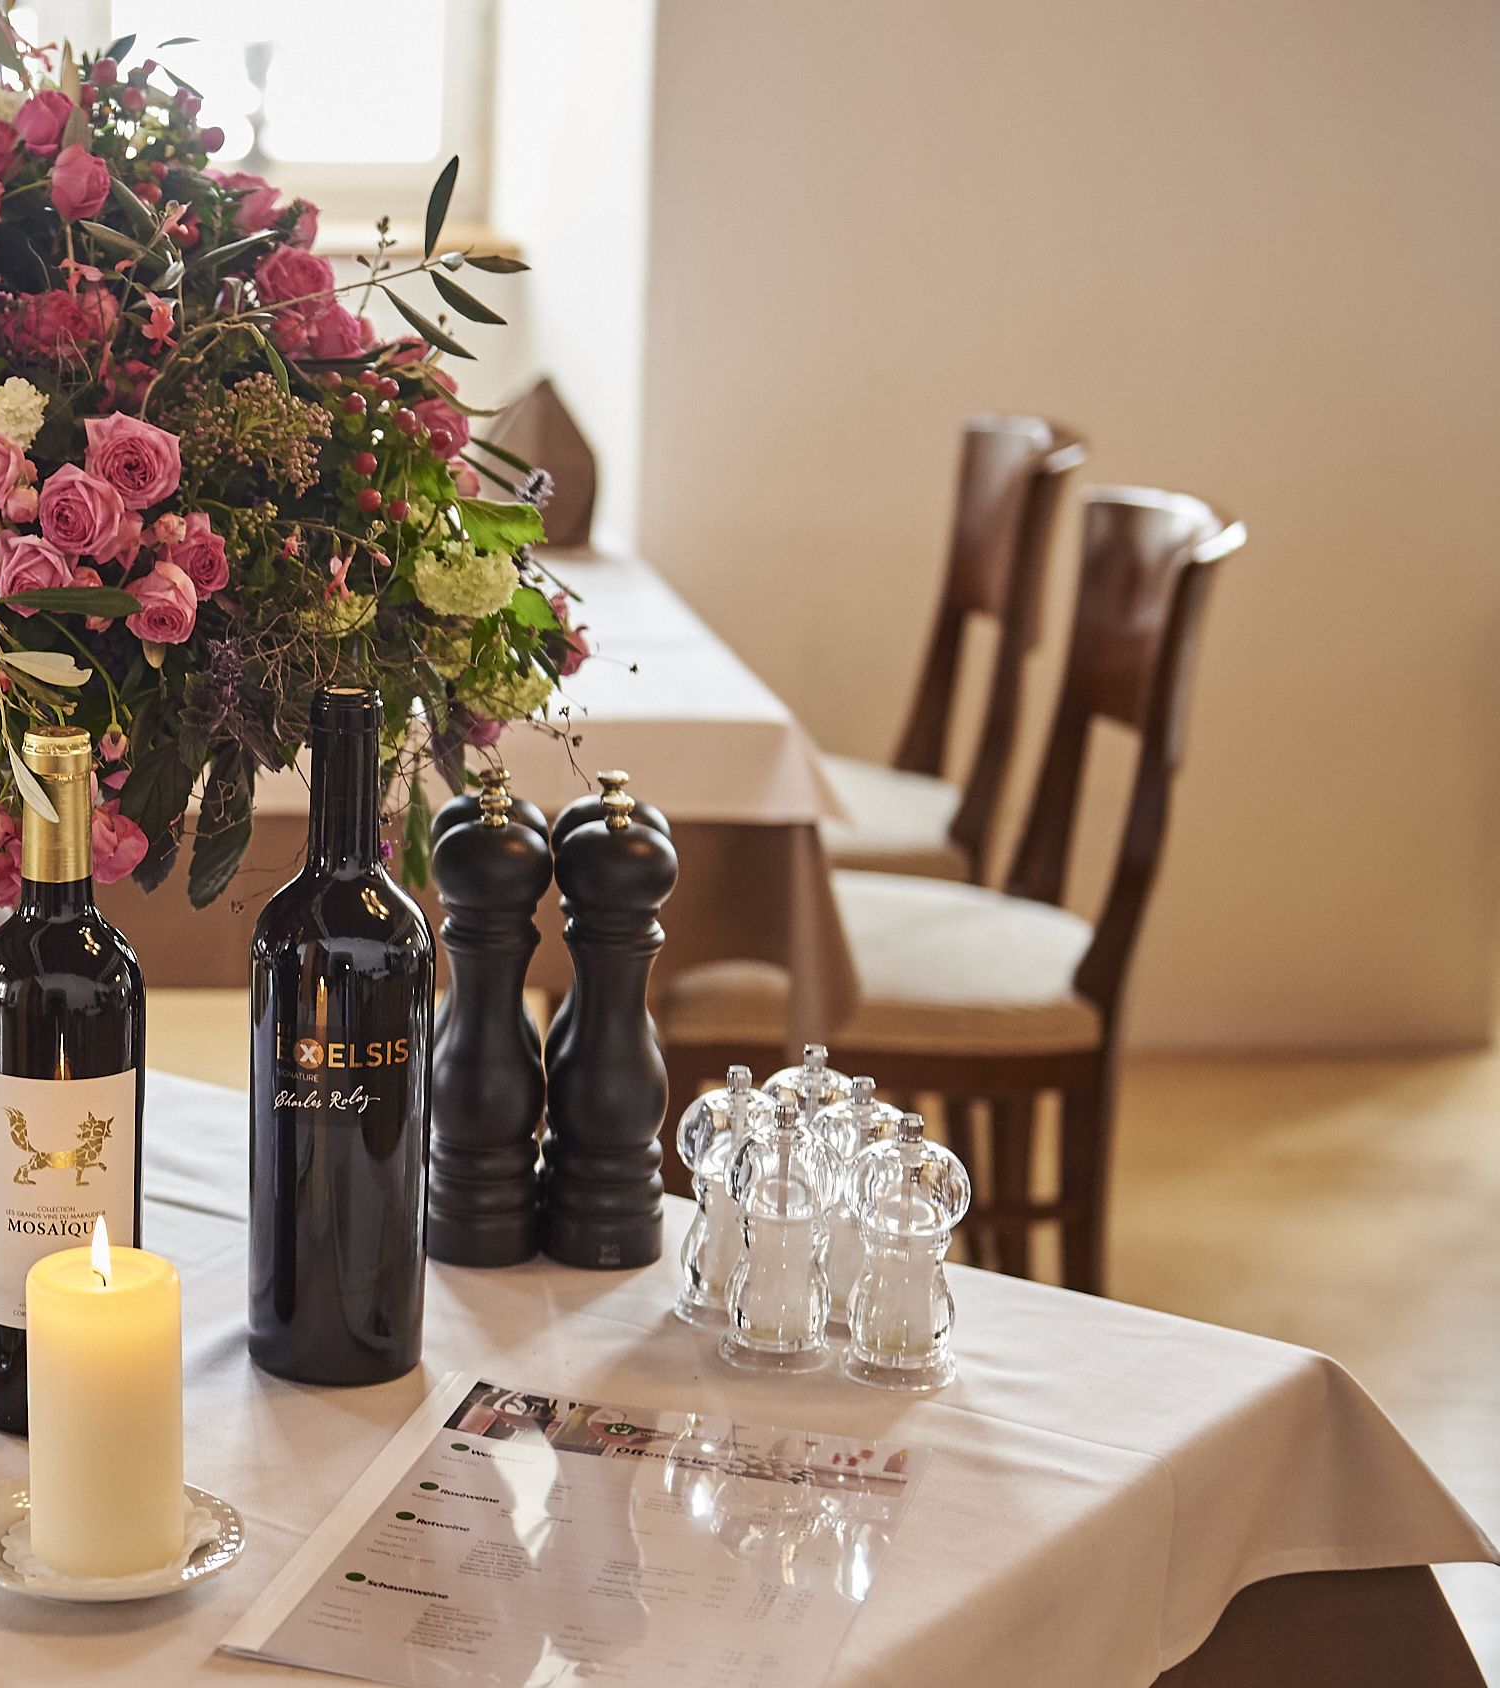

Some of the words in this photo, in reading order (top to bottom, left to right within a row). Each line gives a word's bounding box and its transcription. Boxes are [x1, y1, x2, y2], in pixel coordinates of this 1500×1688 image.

[17, 1210, 41, 1219] GRANDS
[8, 1218, 95, 1238] MOSAÏQU
[416, 1518, 470, 1532] Rotweine
